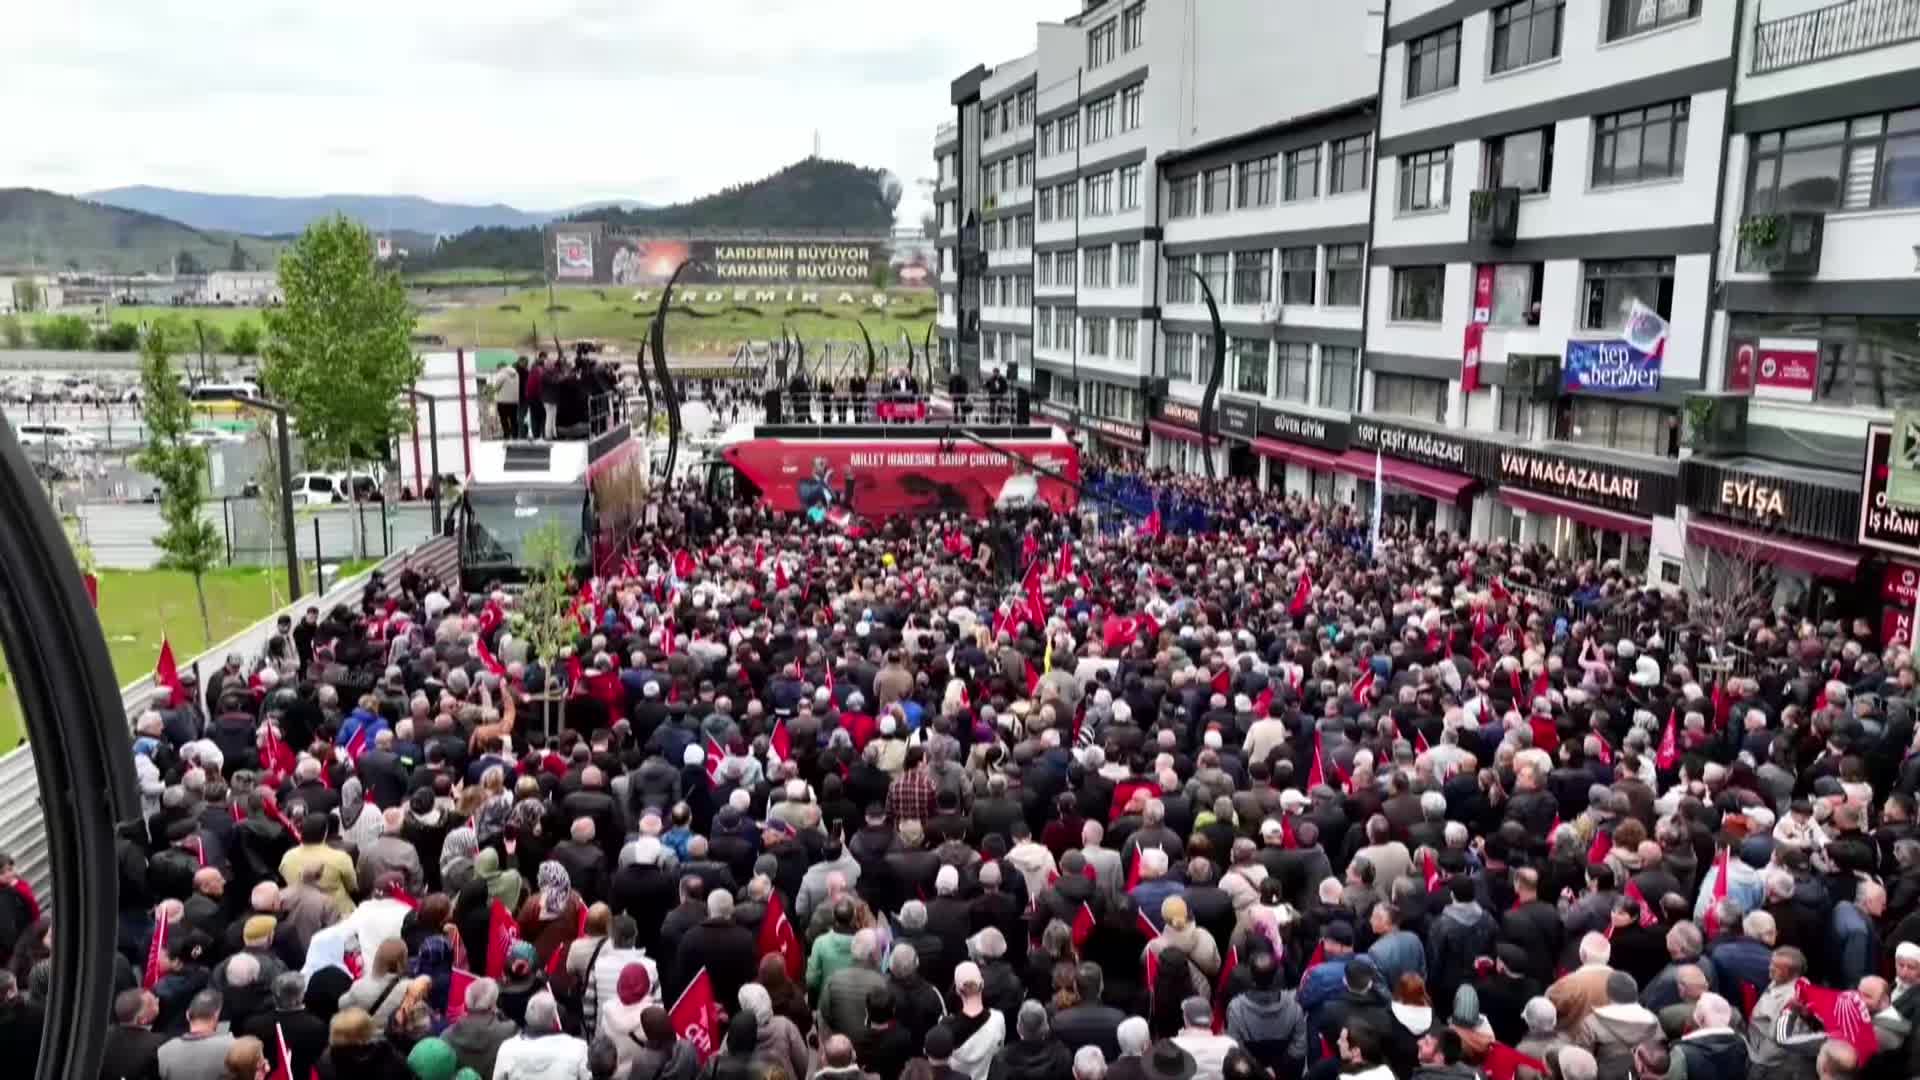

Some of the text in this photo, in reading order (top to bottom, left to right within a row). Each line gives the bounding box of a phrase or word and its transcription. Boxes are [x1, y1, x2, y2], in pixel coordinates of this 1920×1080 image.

[715, 244, 869, 261] KARDEMİR BÜYÜYOR
[717, 262, 868, 278] KARABÜK BÜYÜYOR
[1599, 343, 1629, 370] hep
[1591, 362, 1658, 387] beraber
[1274, 414, 1325, 440] GÜVEN GİYİM
[1358, 424, 1464, 464] 1001 ÇEŞİT MAĞAZASI
[1501, 453, 1639, 500] VAV MAĞAZALARI
[1722, 479, 1784, 517] EYİŞA
[1883, 512, 1919, 537] HANI
